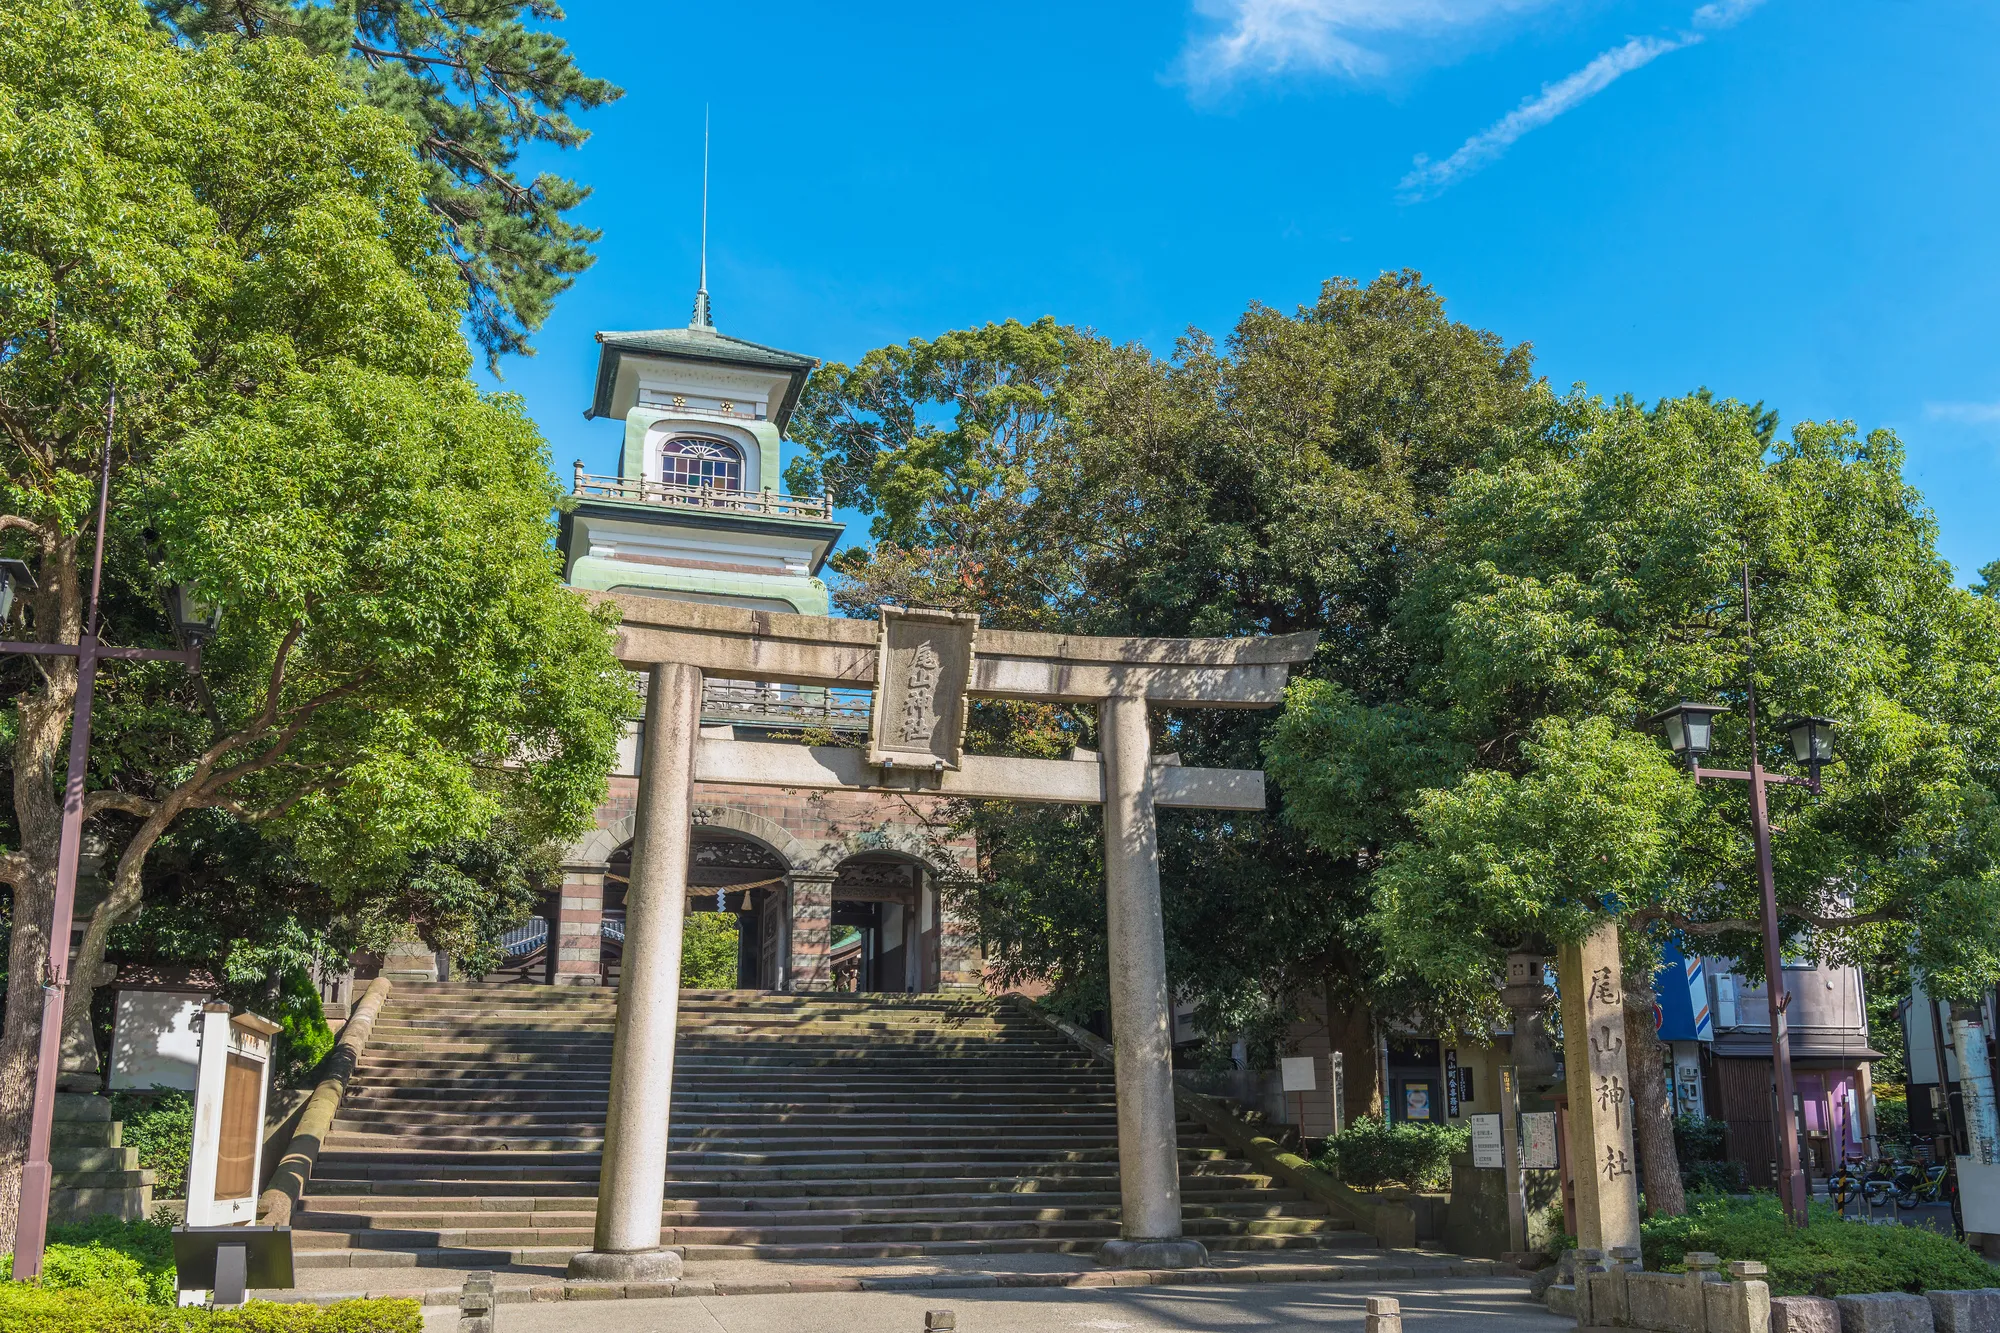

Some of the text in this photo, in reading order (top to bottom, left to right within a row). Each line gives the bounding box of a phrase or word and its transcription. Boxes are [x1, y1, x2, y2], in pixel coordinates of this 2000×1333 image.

[899, 639, 937, 743] 尾山神社
[1588, 966, 1632, 1182] 尾山神社
